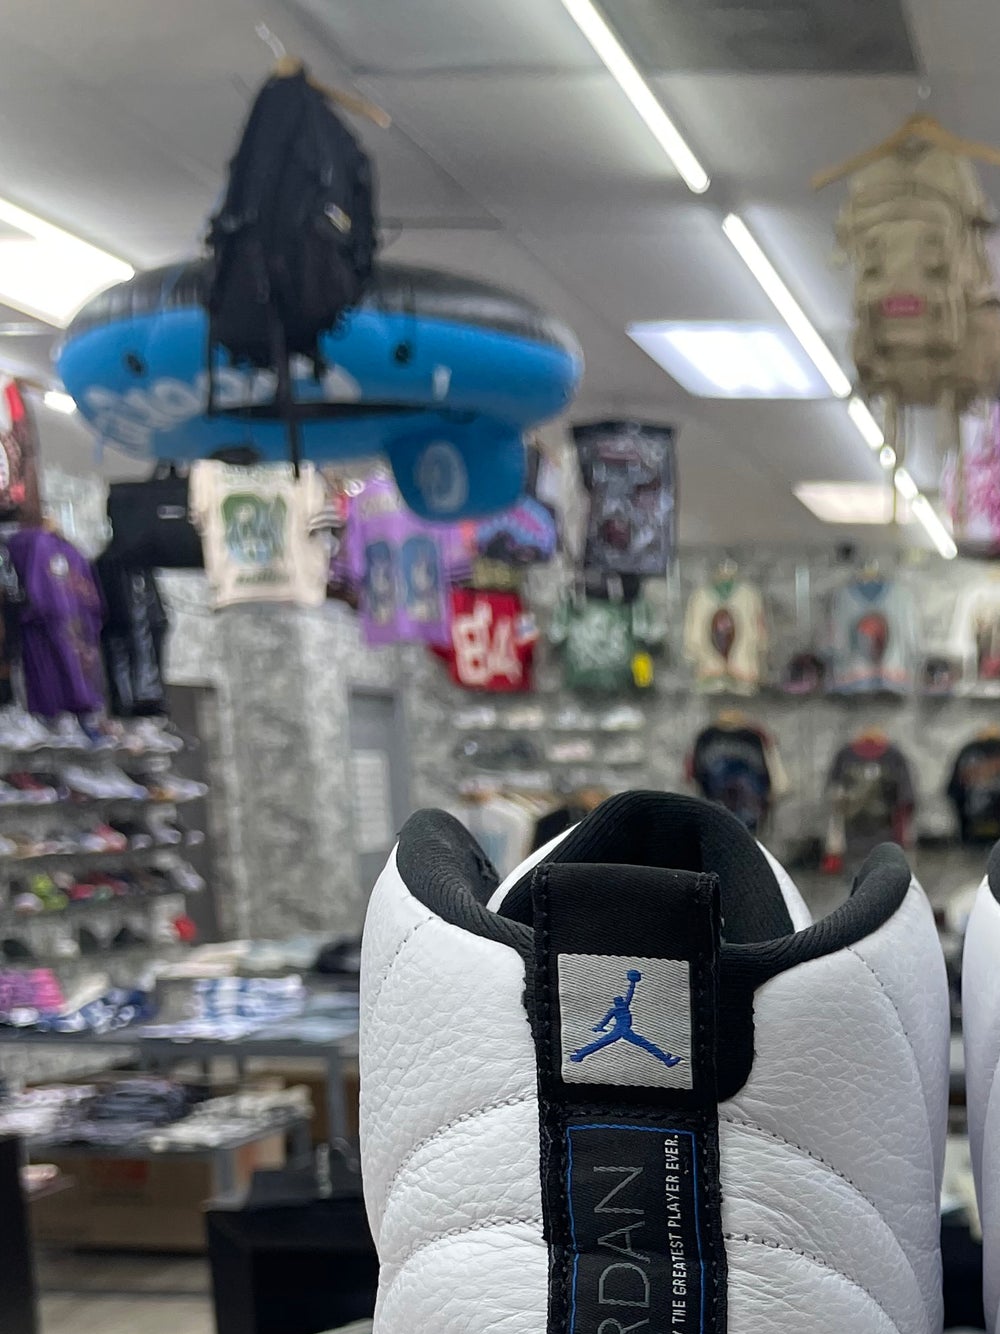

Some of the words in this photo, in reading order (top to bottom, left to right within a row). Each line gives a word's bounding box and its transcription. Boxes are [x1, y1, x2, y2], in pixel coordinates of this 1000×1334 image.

[664, 1134, 680, 1170] EVER.
[665, 1175, 682, 1227] PLAYER
[668, 1232, 687, 1296] GREATEST
[672, 1300, 687, 1324] THE
